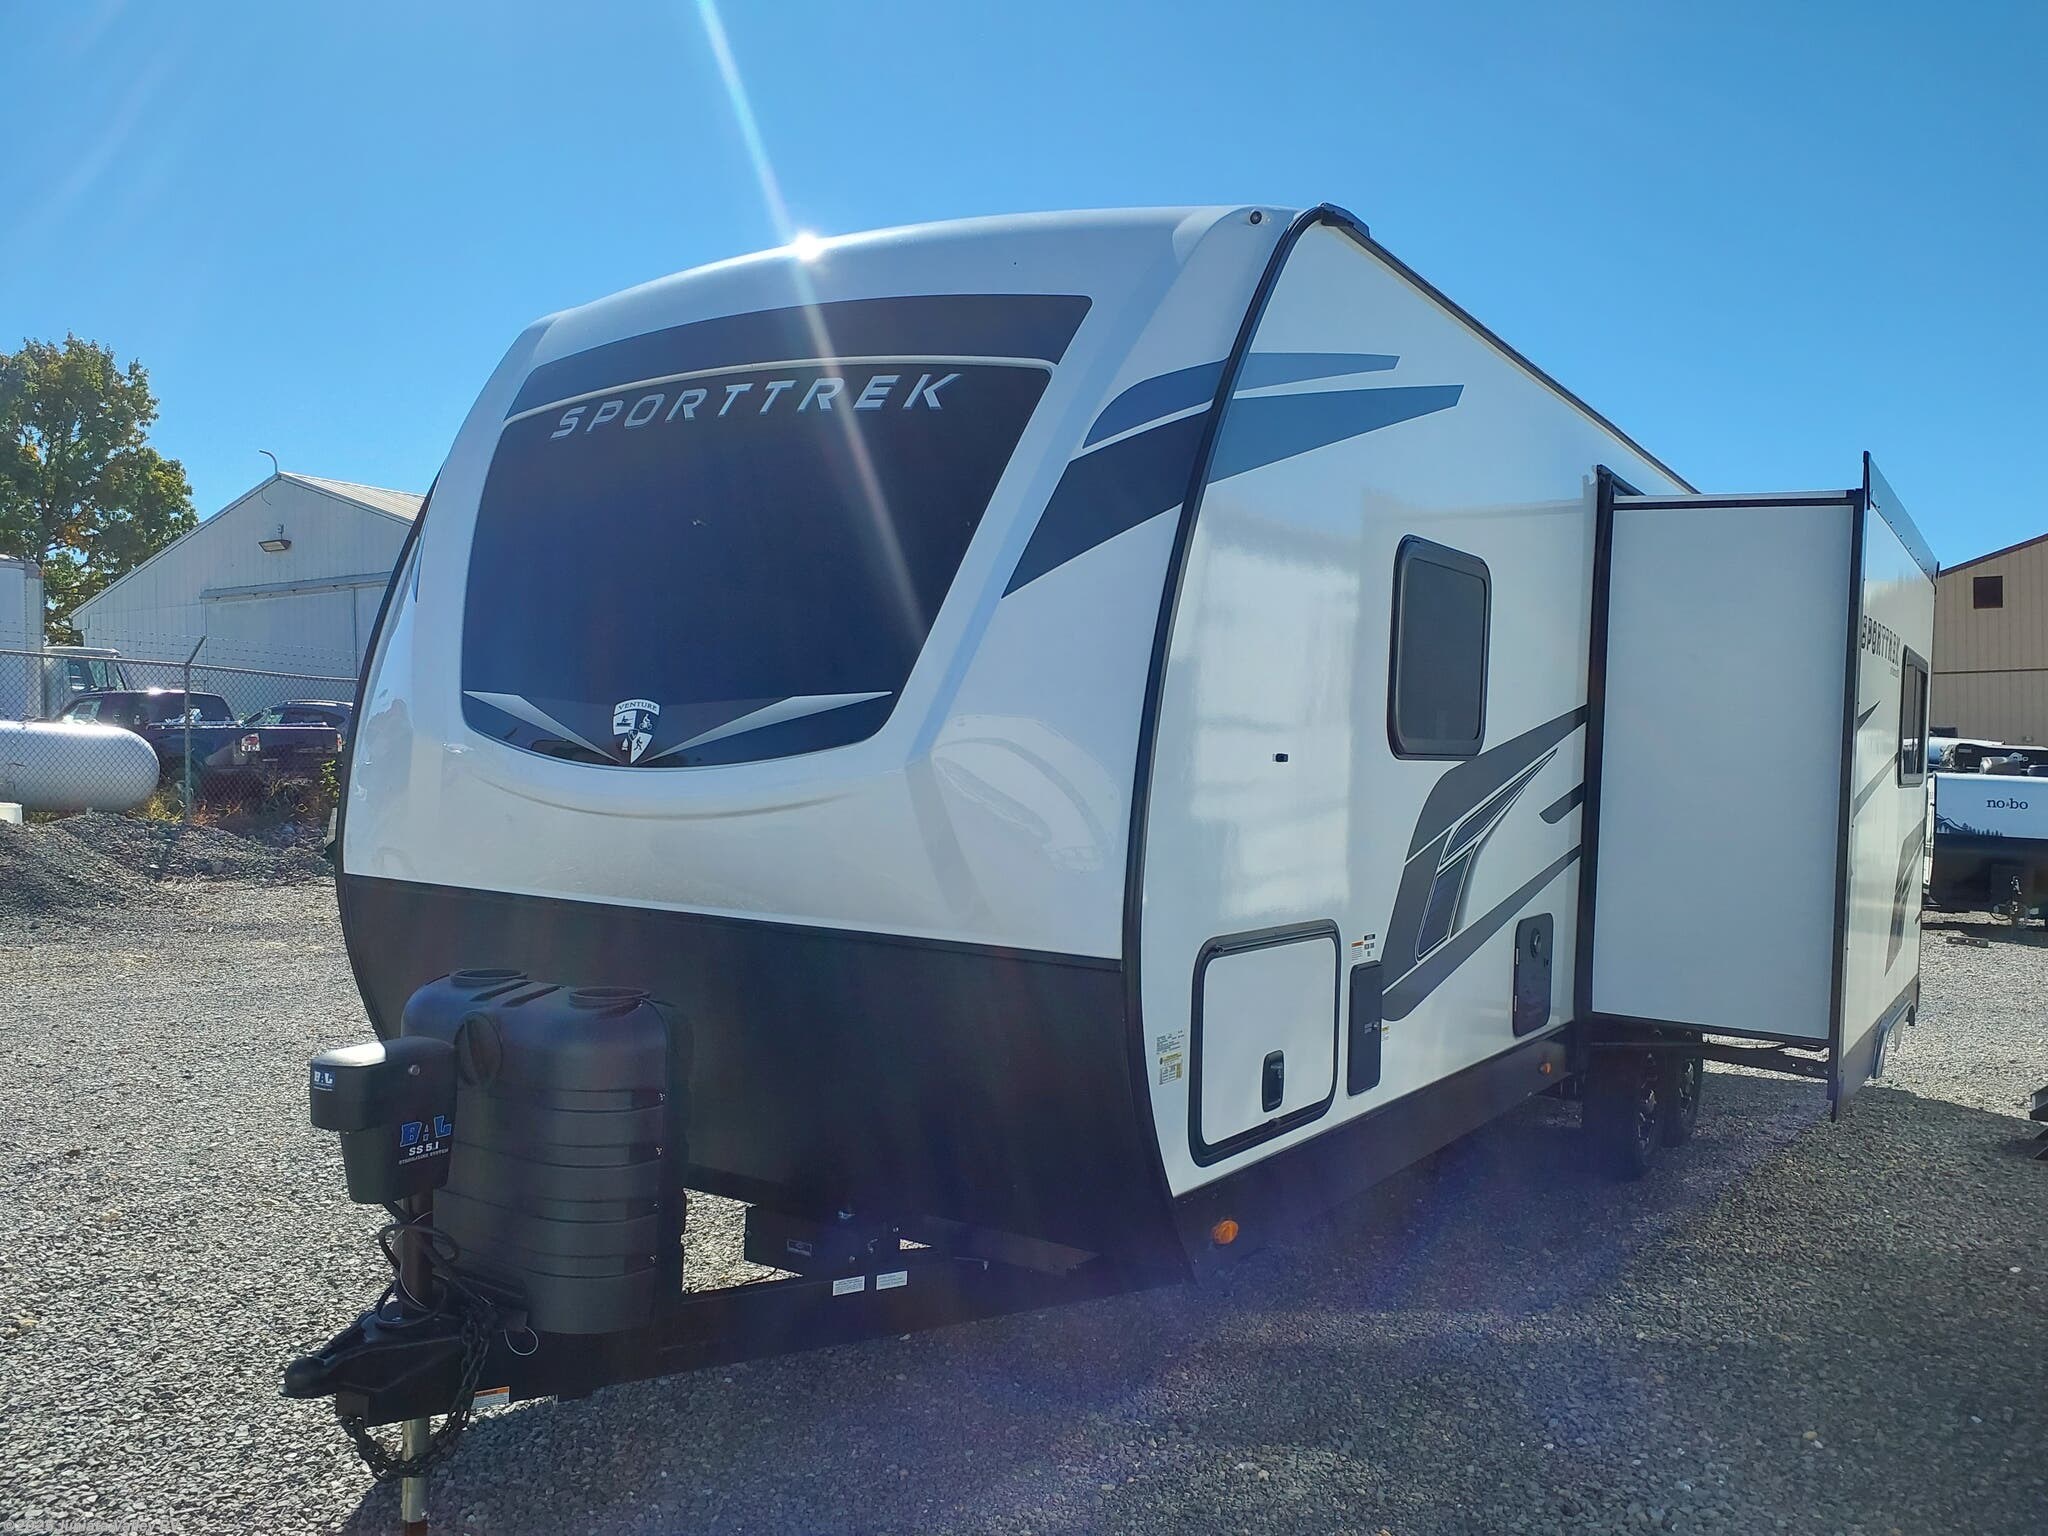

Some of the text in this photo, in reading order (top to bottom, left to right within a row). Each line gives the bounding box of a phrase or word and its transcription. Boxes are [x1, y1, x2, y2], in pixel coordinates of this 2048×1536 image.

[549, 372, 962, 440] SPORTTREK
[1860, 615, 1901, 667] SPORTTREK
[617, 701, 658, 712] VENTURE
